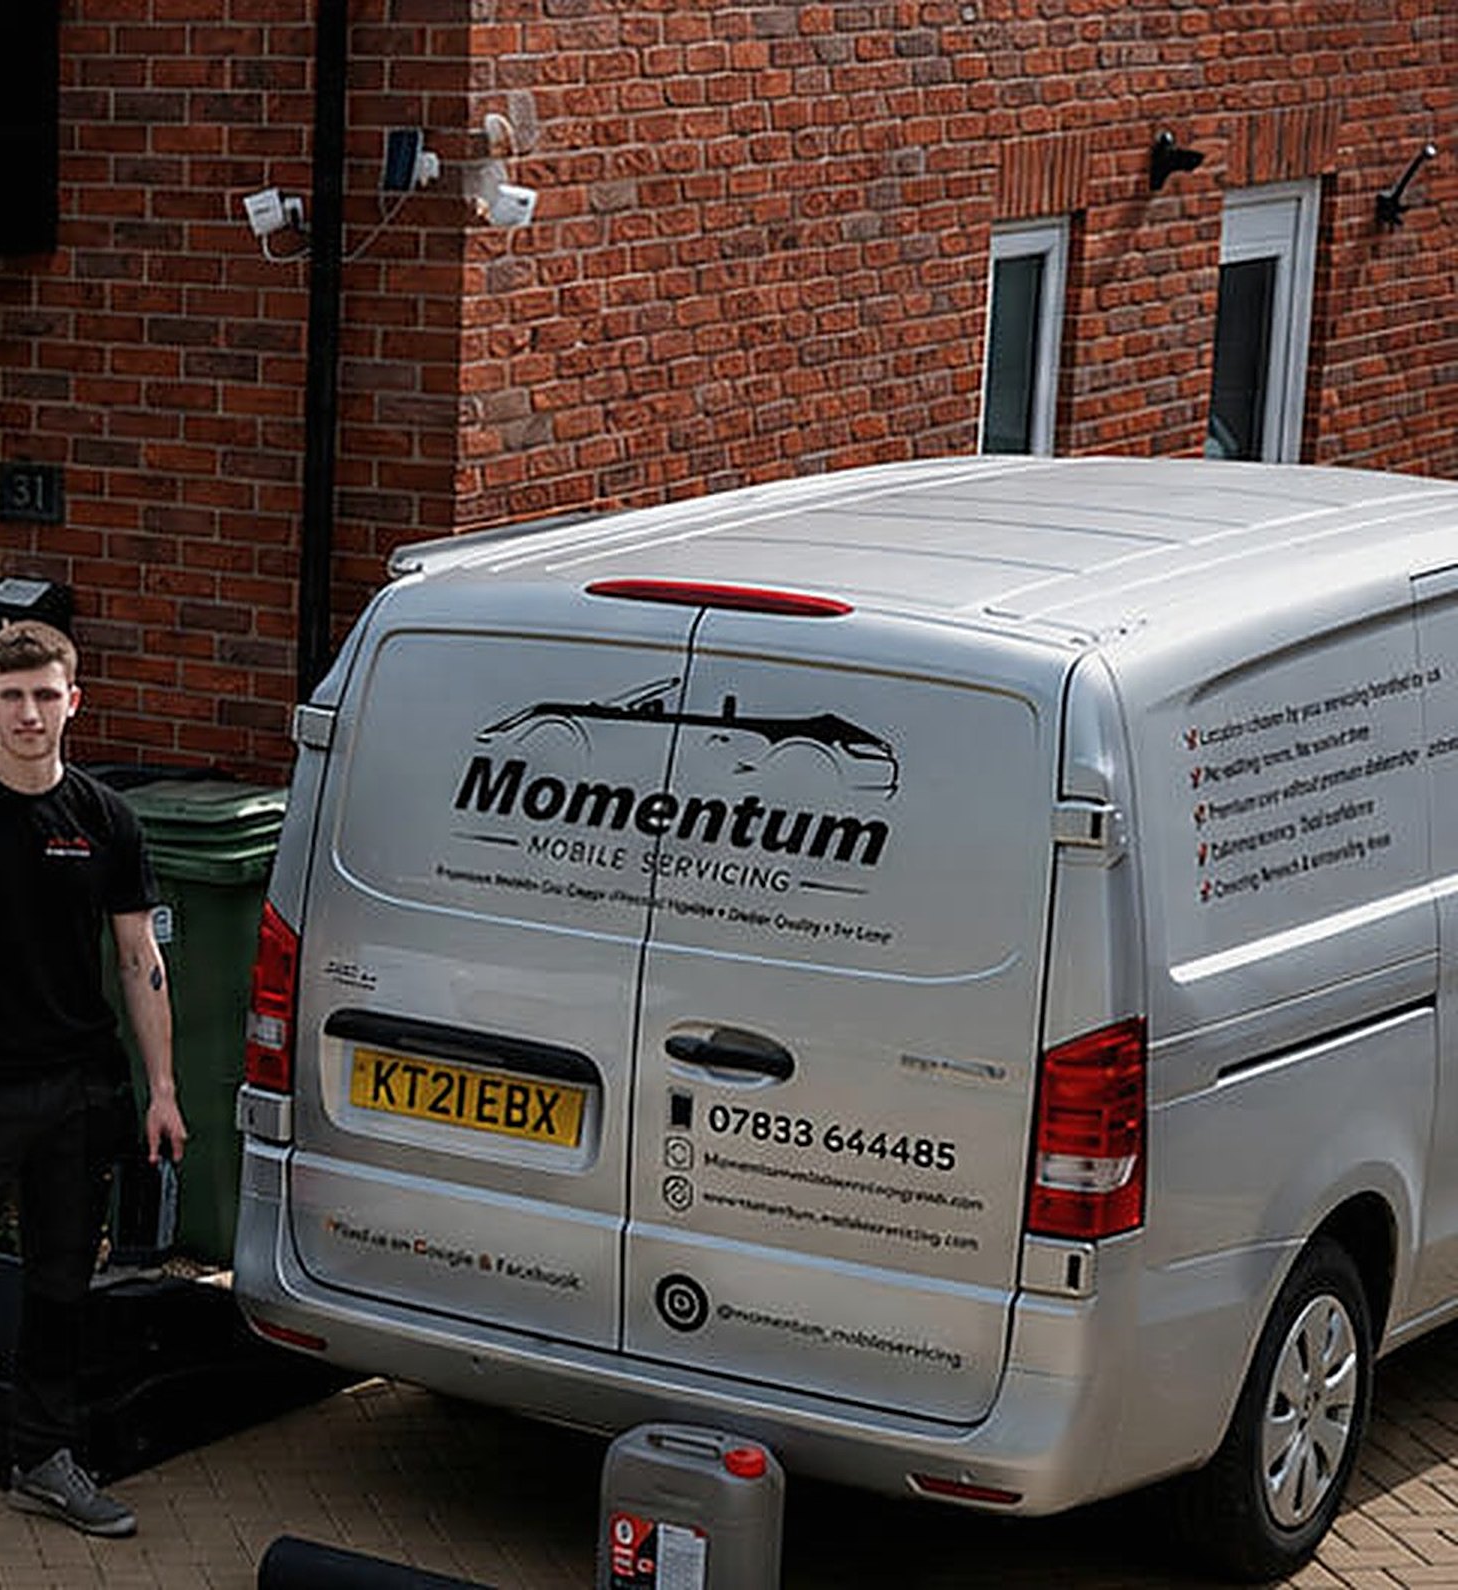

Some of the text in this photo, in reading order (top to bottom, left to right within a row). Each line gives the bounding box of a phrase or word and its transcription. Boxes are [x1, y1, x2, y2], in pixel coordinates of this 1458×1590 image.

[13, 473, 43, 509] 31
[454, 756, 890, 867] Momentum
[527, 835, 627, 871] MOBILE
[640, 851, 791, 894] SERVICING
[709, 1105, 956, 1171] 07833 644485
